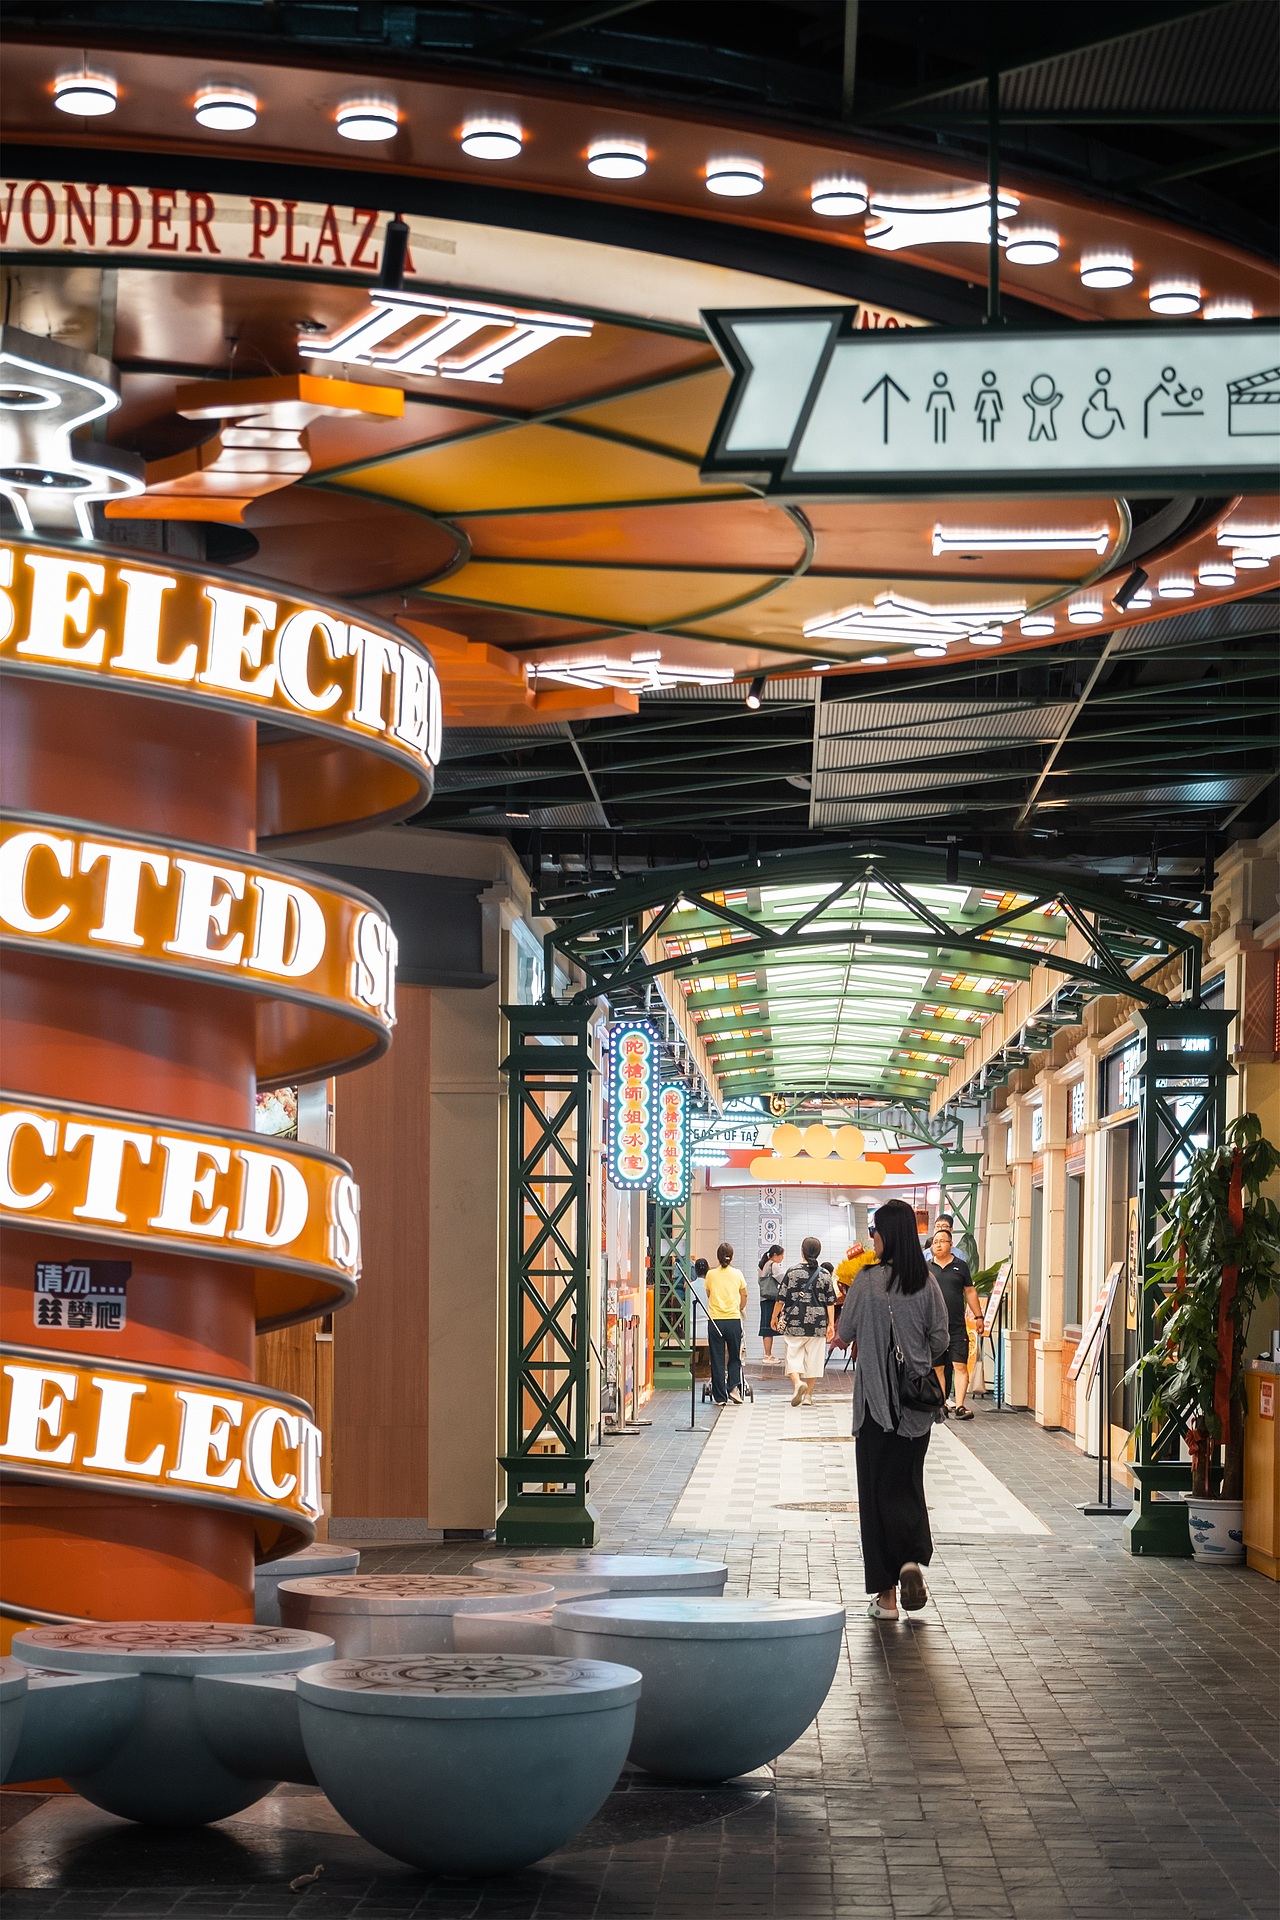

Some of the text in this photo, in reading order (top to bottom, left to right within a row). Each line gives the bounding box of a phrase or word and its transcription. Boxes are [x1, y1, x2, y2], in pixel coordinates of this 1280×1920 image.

[0, 548, 442, 766] ELECTED
[622, 1040, 645, 1171] 陀槍師姐冰室
[663, 1093, 680, 1193] 陀槍師姐冰室
[724, 1130, 737, 1142] OF
[67, 1300, 122, 1330] 攀爬
